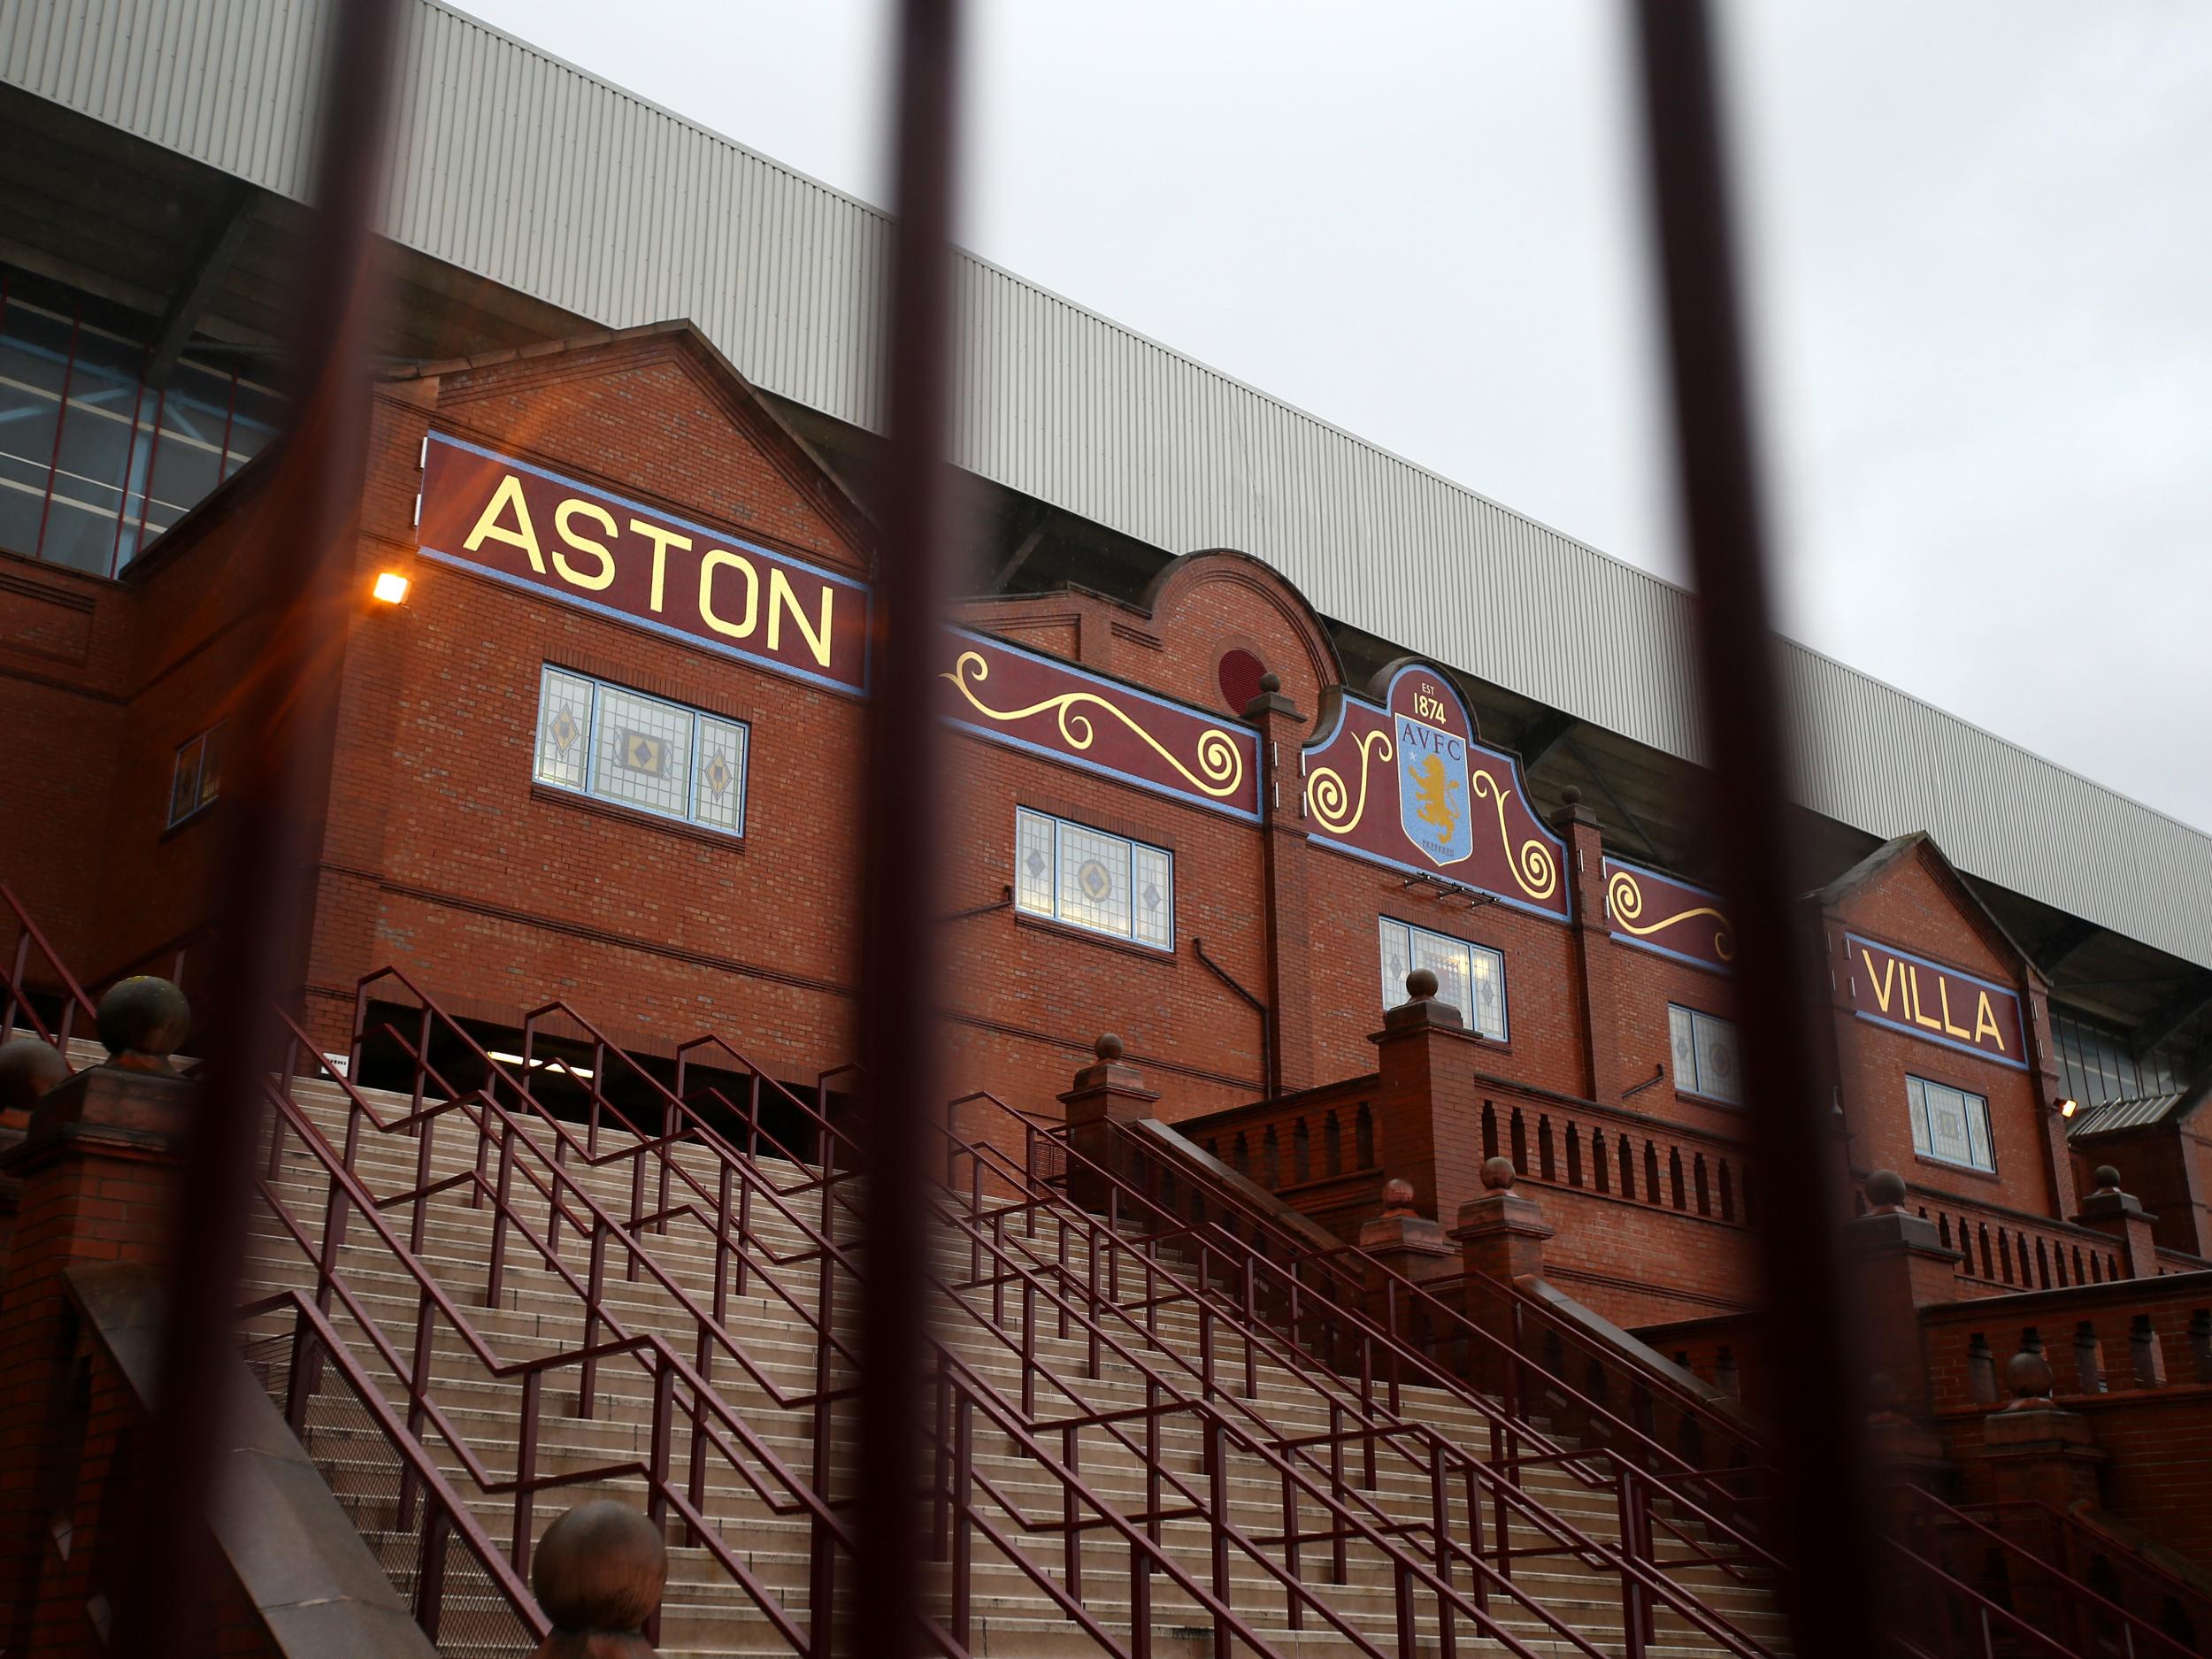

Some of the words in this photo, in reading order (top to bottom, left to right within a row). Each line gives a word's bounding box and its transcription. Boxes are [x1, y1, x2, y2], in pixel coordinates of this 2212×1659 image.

[462, 474, 833, 668] ASTON
[1422, 682, 1435, 695] EST
[1413, 692, 1447, 725] 1874
[1402, 722, 1462, 761] AVFC
[1422, 839, 1455, 857] PREPARED
[1862, 949, 2005, 1051] VILLA
